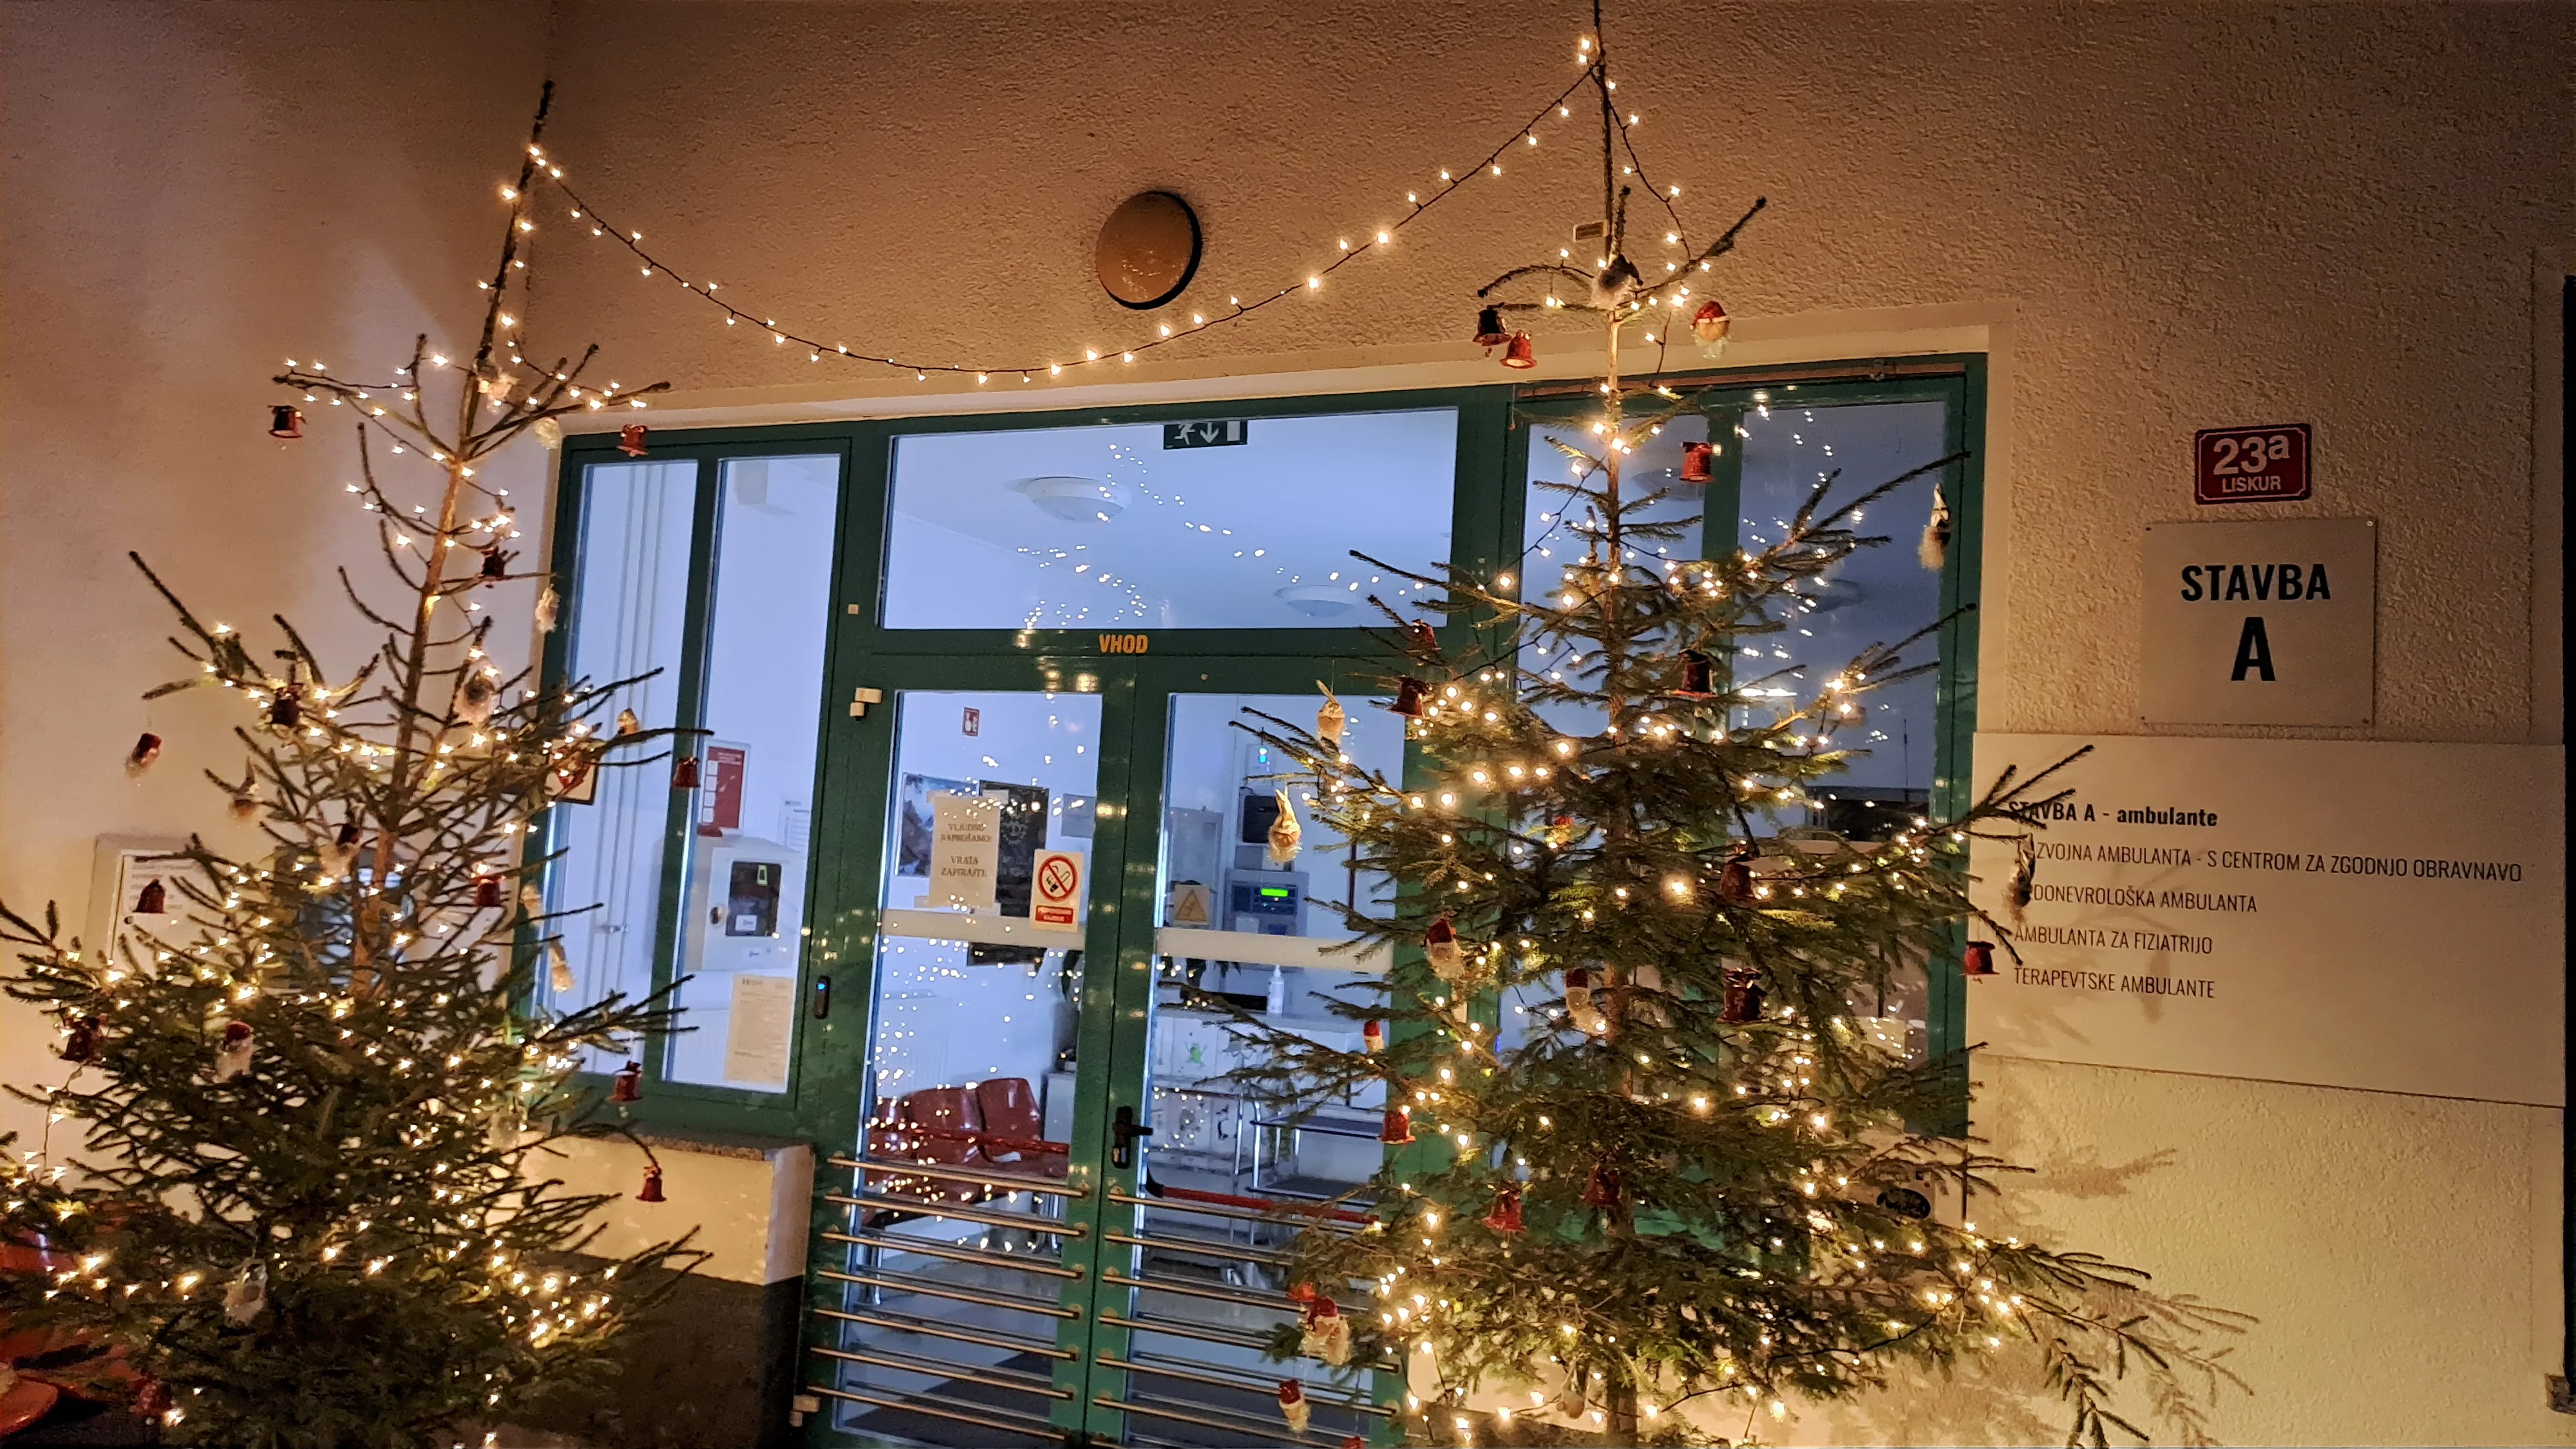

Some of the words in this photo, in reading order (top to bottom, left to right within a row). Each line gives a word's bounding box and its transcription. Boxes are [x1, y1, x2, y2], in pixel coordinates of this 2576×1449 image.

[2213, 434, 2291, 475] 23a
[2222, 475, 2282, 493] LISKUR
[2180, 563, 2331, 602] STAVBA
[1099, 633, 1148, 654] VHOD
[2230, 616, 2277, 682] A
[2084, 804, 2096, 822] A
[2116, 806, 2218, 826] ambulante
[2036, 841, 2092, 862] ZVOJNA
[2097, 845, 2192, 866] AMBULANTA
[2207, 850, 2217, 868] S
[2222, 851, 2300, 871] CENTROM
[2306, 854, 2325, 873] ZA
[2331, 855, 2407, 877] ZGODNJO
[2413, 858, 2522, 882] OBRAVNAVO
[2034, 884, 2155, 907] DONEVROLOŠKA
[2160, 891, 2257, 913] AMBULANTA
[2014, 925, 2106, 947] AMBULANTA
[2111, 931, 2129, 949] ZA
[2134, 932, 2213, 954] FIZIATRIJO
[2014, 967, 2116, 992] TERAPEVTSKE
[2120, 974, 2215, 999] AMBULANTE
